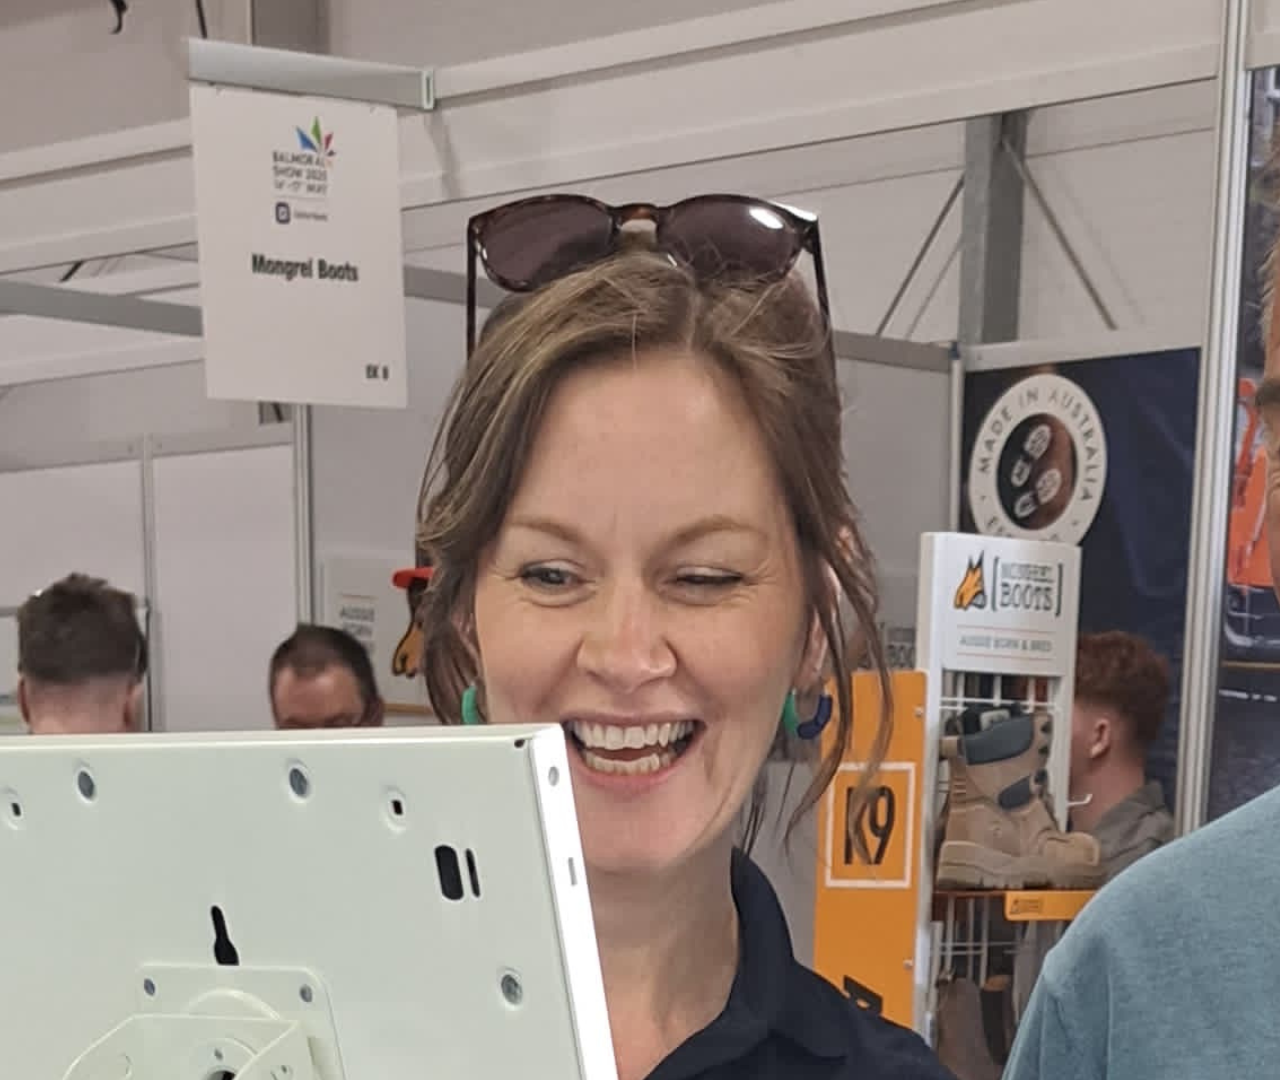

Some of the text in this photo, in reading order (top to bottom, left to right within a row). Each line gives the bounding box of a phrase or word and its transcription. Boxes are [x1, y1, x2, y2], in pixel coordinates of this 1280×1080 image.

[252, 253, 359, 283] Mongrel Boots
[978, 388, 1100, 501] MADE IN AUSTRALIA
[1000, 582, 1053, 611] BOOTS
[842, 785, 896, 868] K9
